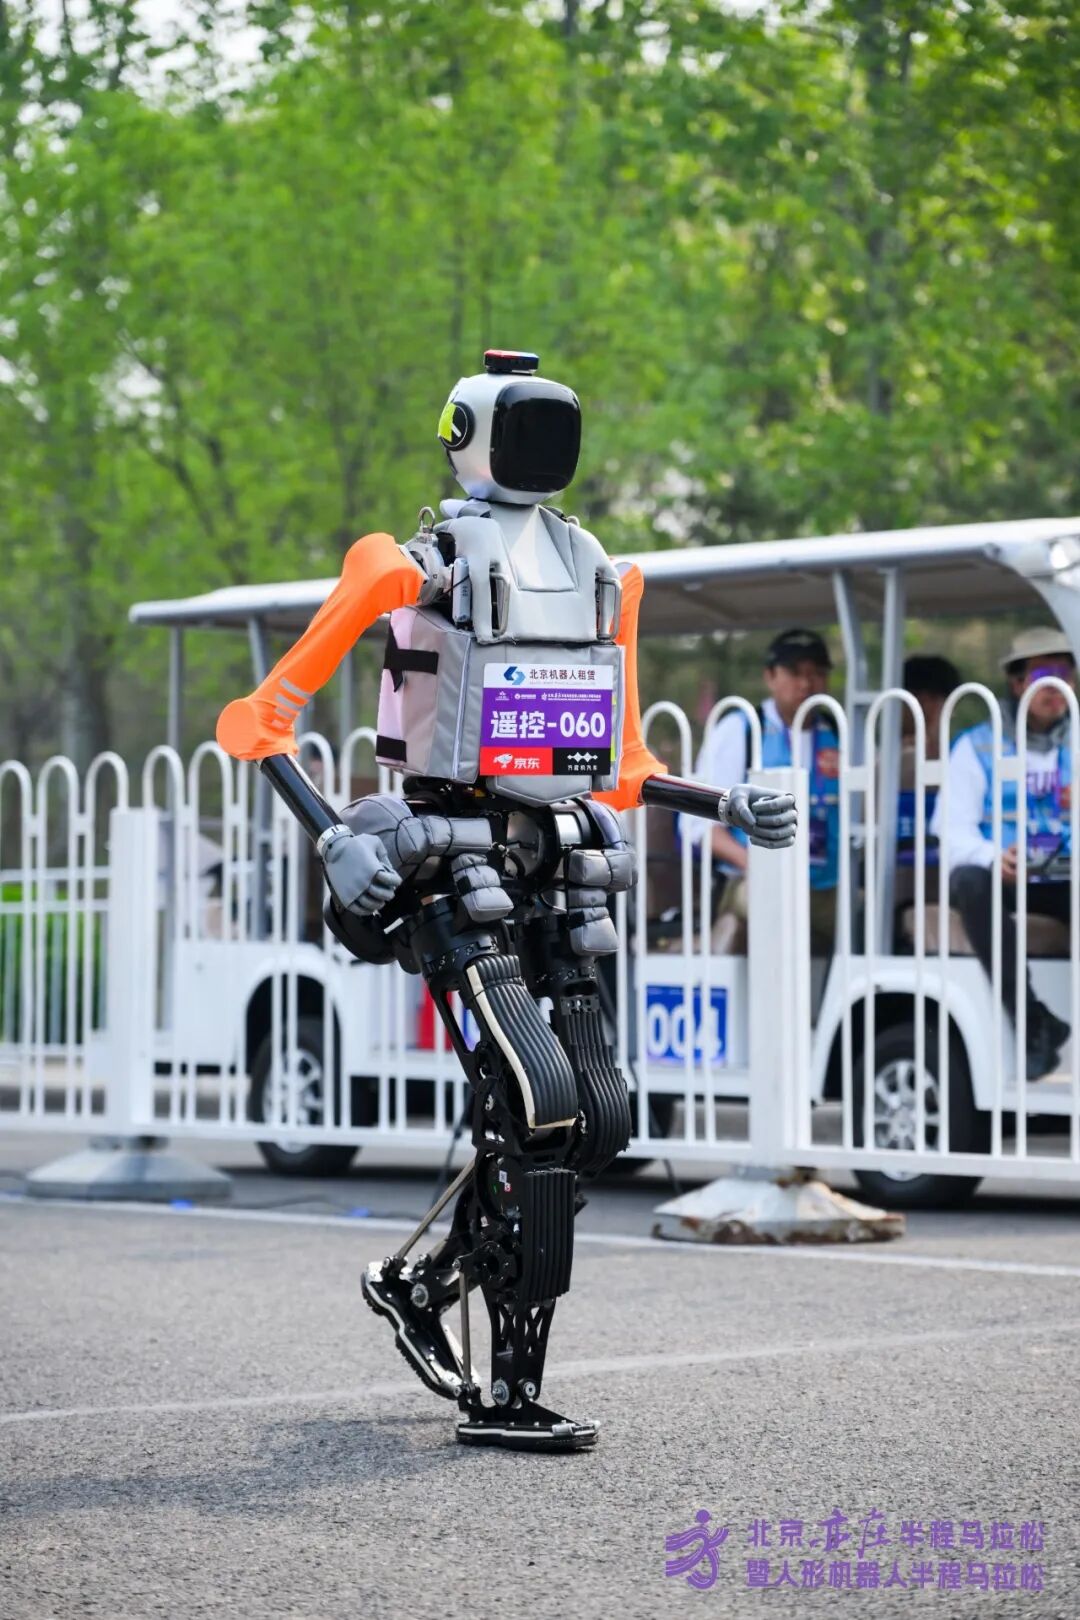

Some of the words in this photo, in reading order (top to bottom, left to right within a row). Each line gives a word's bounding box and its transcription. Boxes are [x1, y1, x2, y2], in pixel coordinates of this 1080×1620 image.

[529, 668, 596, 681] 北京机器人租赁
[490, 710, 606, 739] 遥控-060
[514, 757, 540, 769] 京东
